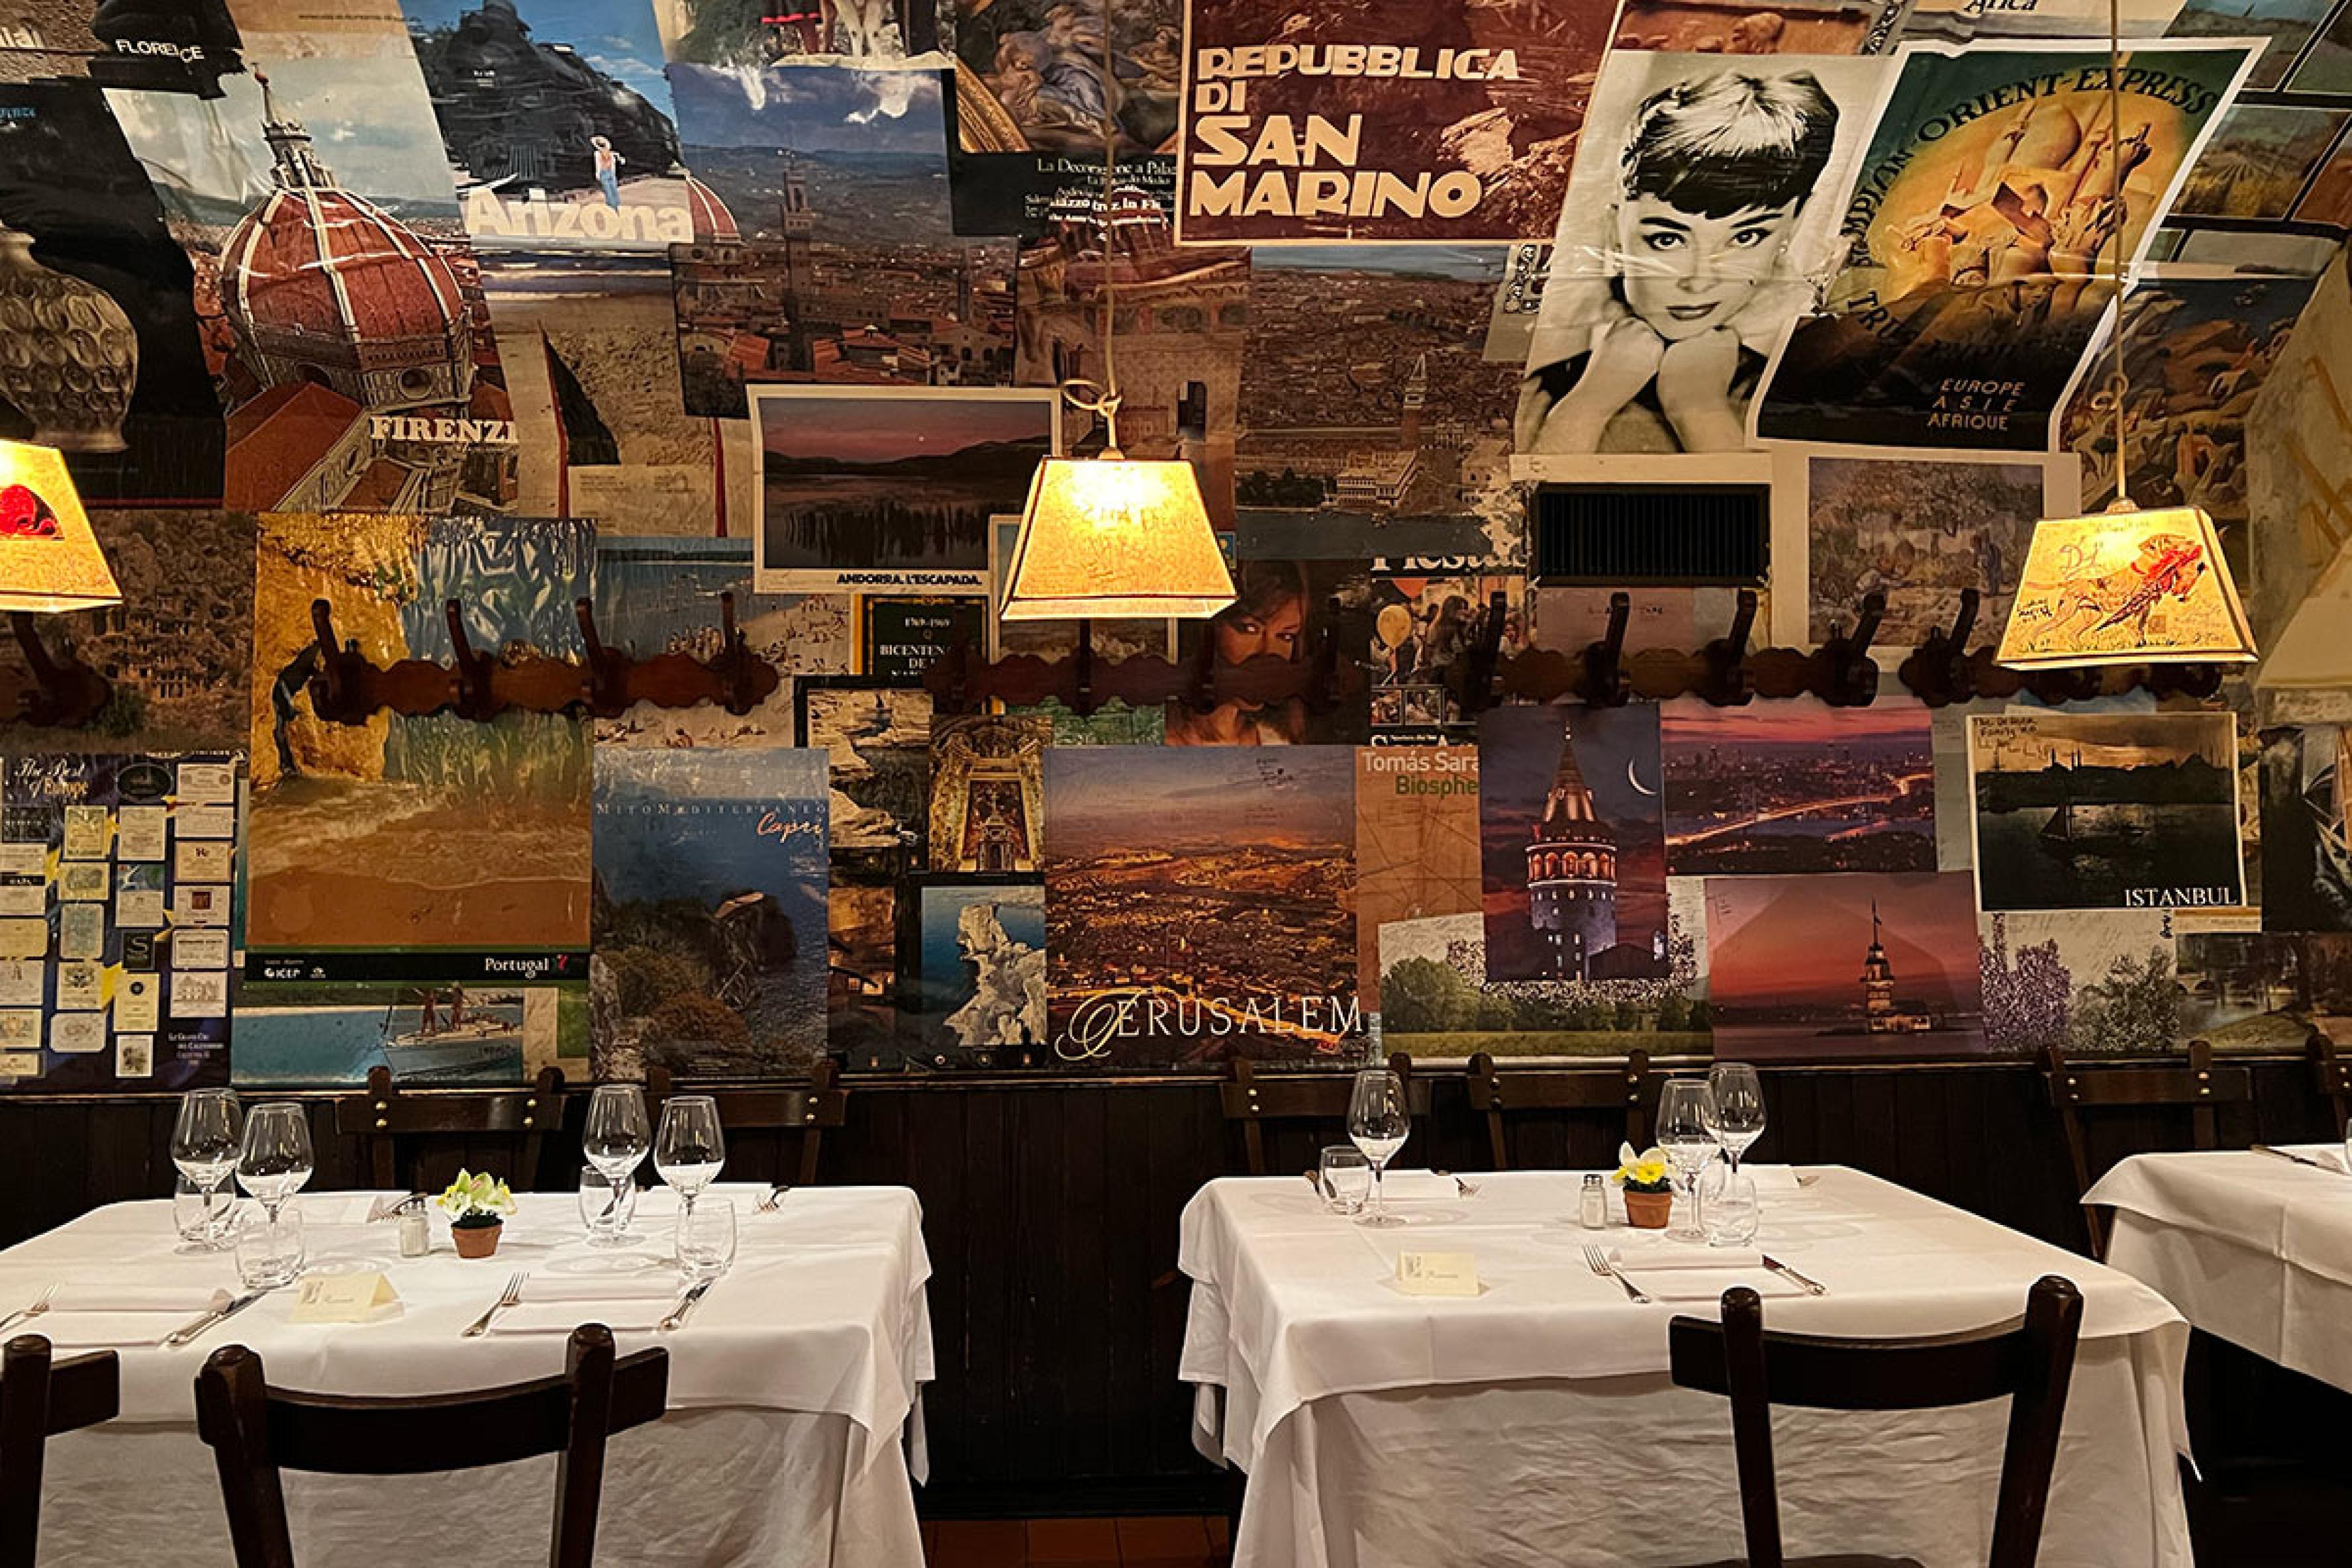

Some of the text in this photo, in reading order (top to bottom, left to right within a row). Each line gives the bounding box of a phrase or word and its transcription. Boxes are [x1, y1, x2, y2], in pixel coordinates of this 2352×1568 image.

[1197, 44, 1520, 80] REPUBBLICA
[1195, 80, 1246, 113] DI
[1193, 114, 1363, 166] SAN
[1189, 171, 1483, 218] MARINO
[467, 187, 693, 243] Arizona
[1939, 378, 2026, 396] EUROPE
[1931, 394, 2018, 413] ASIE
[1926, 413, 2009, 431] AFRIQUE
[879, 644, 951, 655] BICENTEN
[1362, 750, 1431, 772] Tomás
[1395, 774, 1478, 800] Biosphe
[2125, 887, 2237, 907] ISTANBUL
[484, 956, 549, 980] Portugal
[1054, 991, 1363, 1061] JERUSALEM
